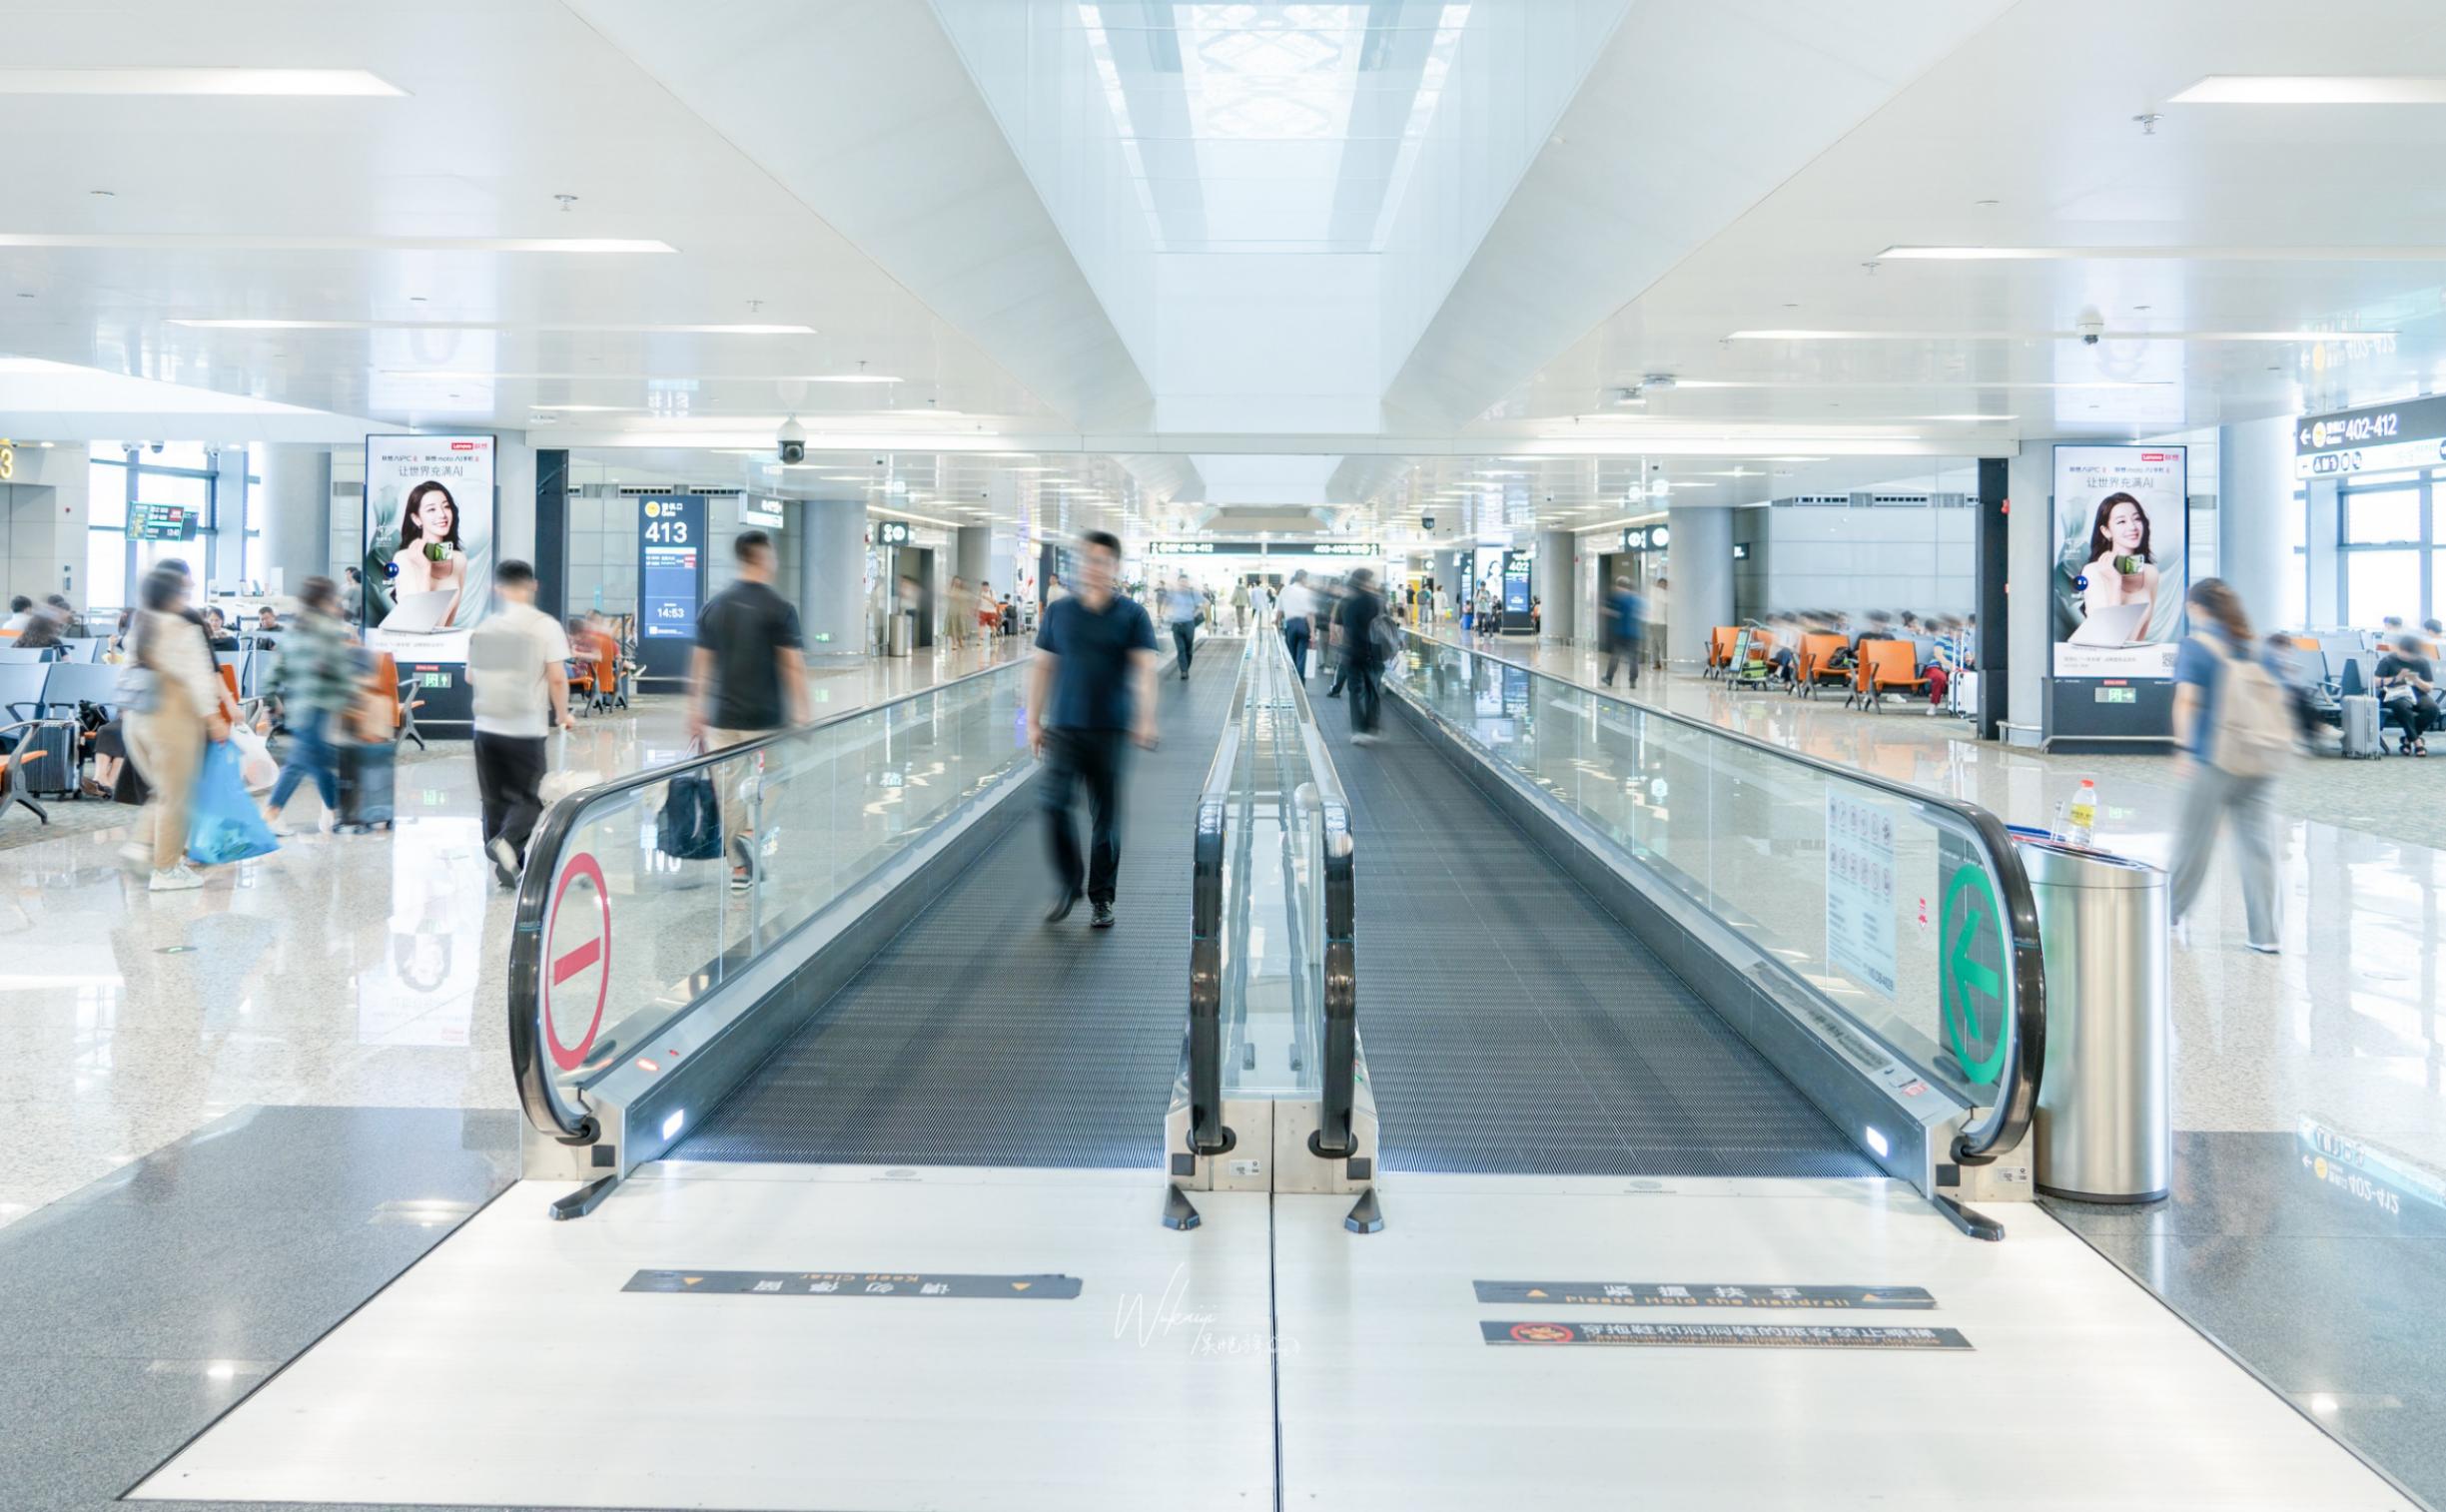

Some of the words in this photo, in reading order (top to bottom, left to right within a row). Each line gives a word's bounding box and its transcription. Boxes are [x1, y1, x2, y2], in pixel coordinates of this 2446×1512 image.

[2345, 412, 2398, 440] 402-412
[400, 465, 463, 477] 让世界充满AI
[2086, 477, 2154, 488] 让世界充满AI
[645, 521, 687, 543] 413
[1508, 560, 1529, 571] 402
[657, 607, 684, 618] 14:53
[800, 1273, 855, 1282] Clear
[865, 1273, 919, 1282] Keep
[753, 1279, 951, 1295] 请勿停留
[1603, 1284, 1802, 1298] 紧握扶手
[1565, 1294, 1636, 1304] Please
[1645, 1296, 1698, 1305] Hold
[1705, 1296, 1743, 1305] the
[1752, 1297, 1850, 1307] Handrail
